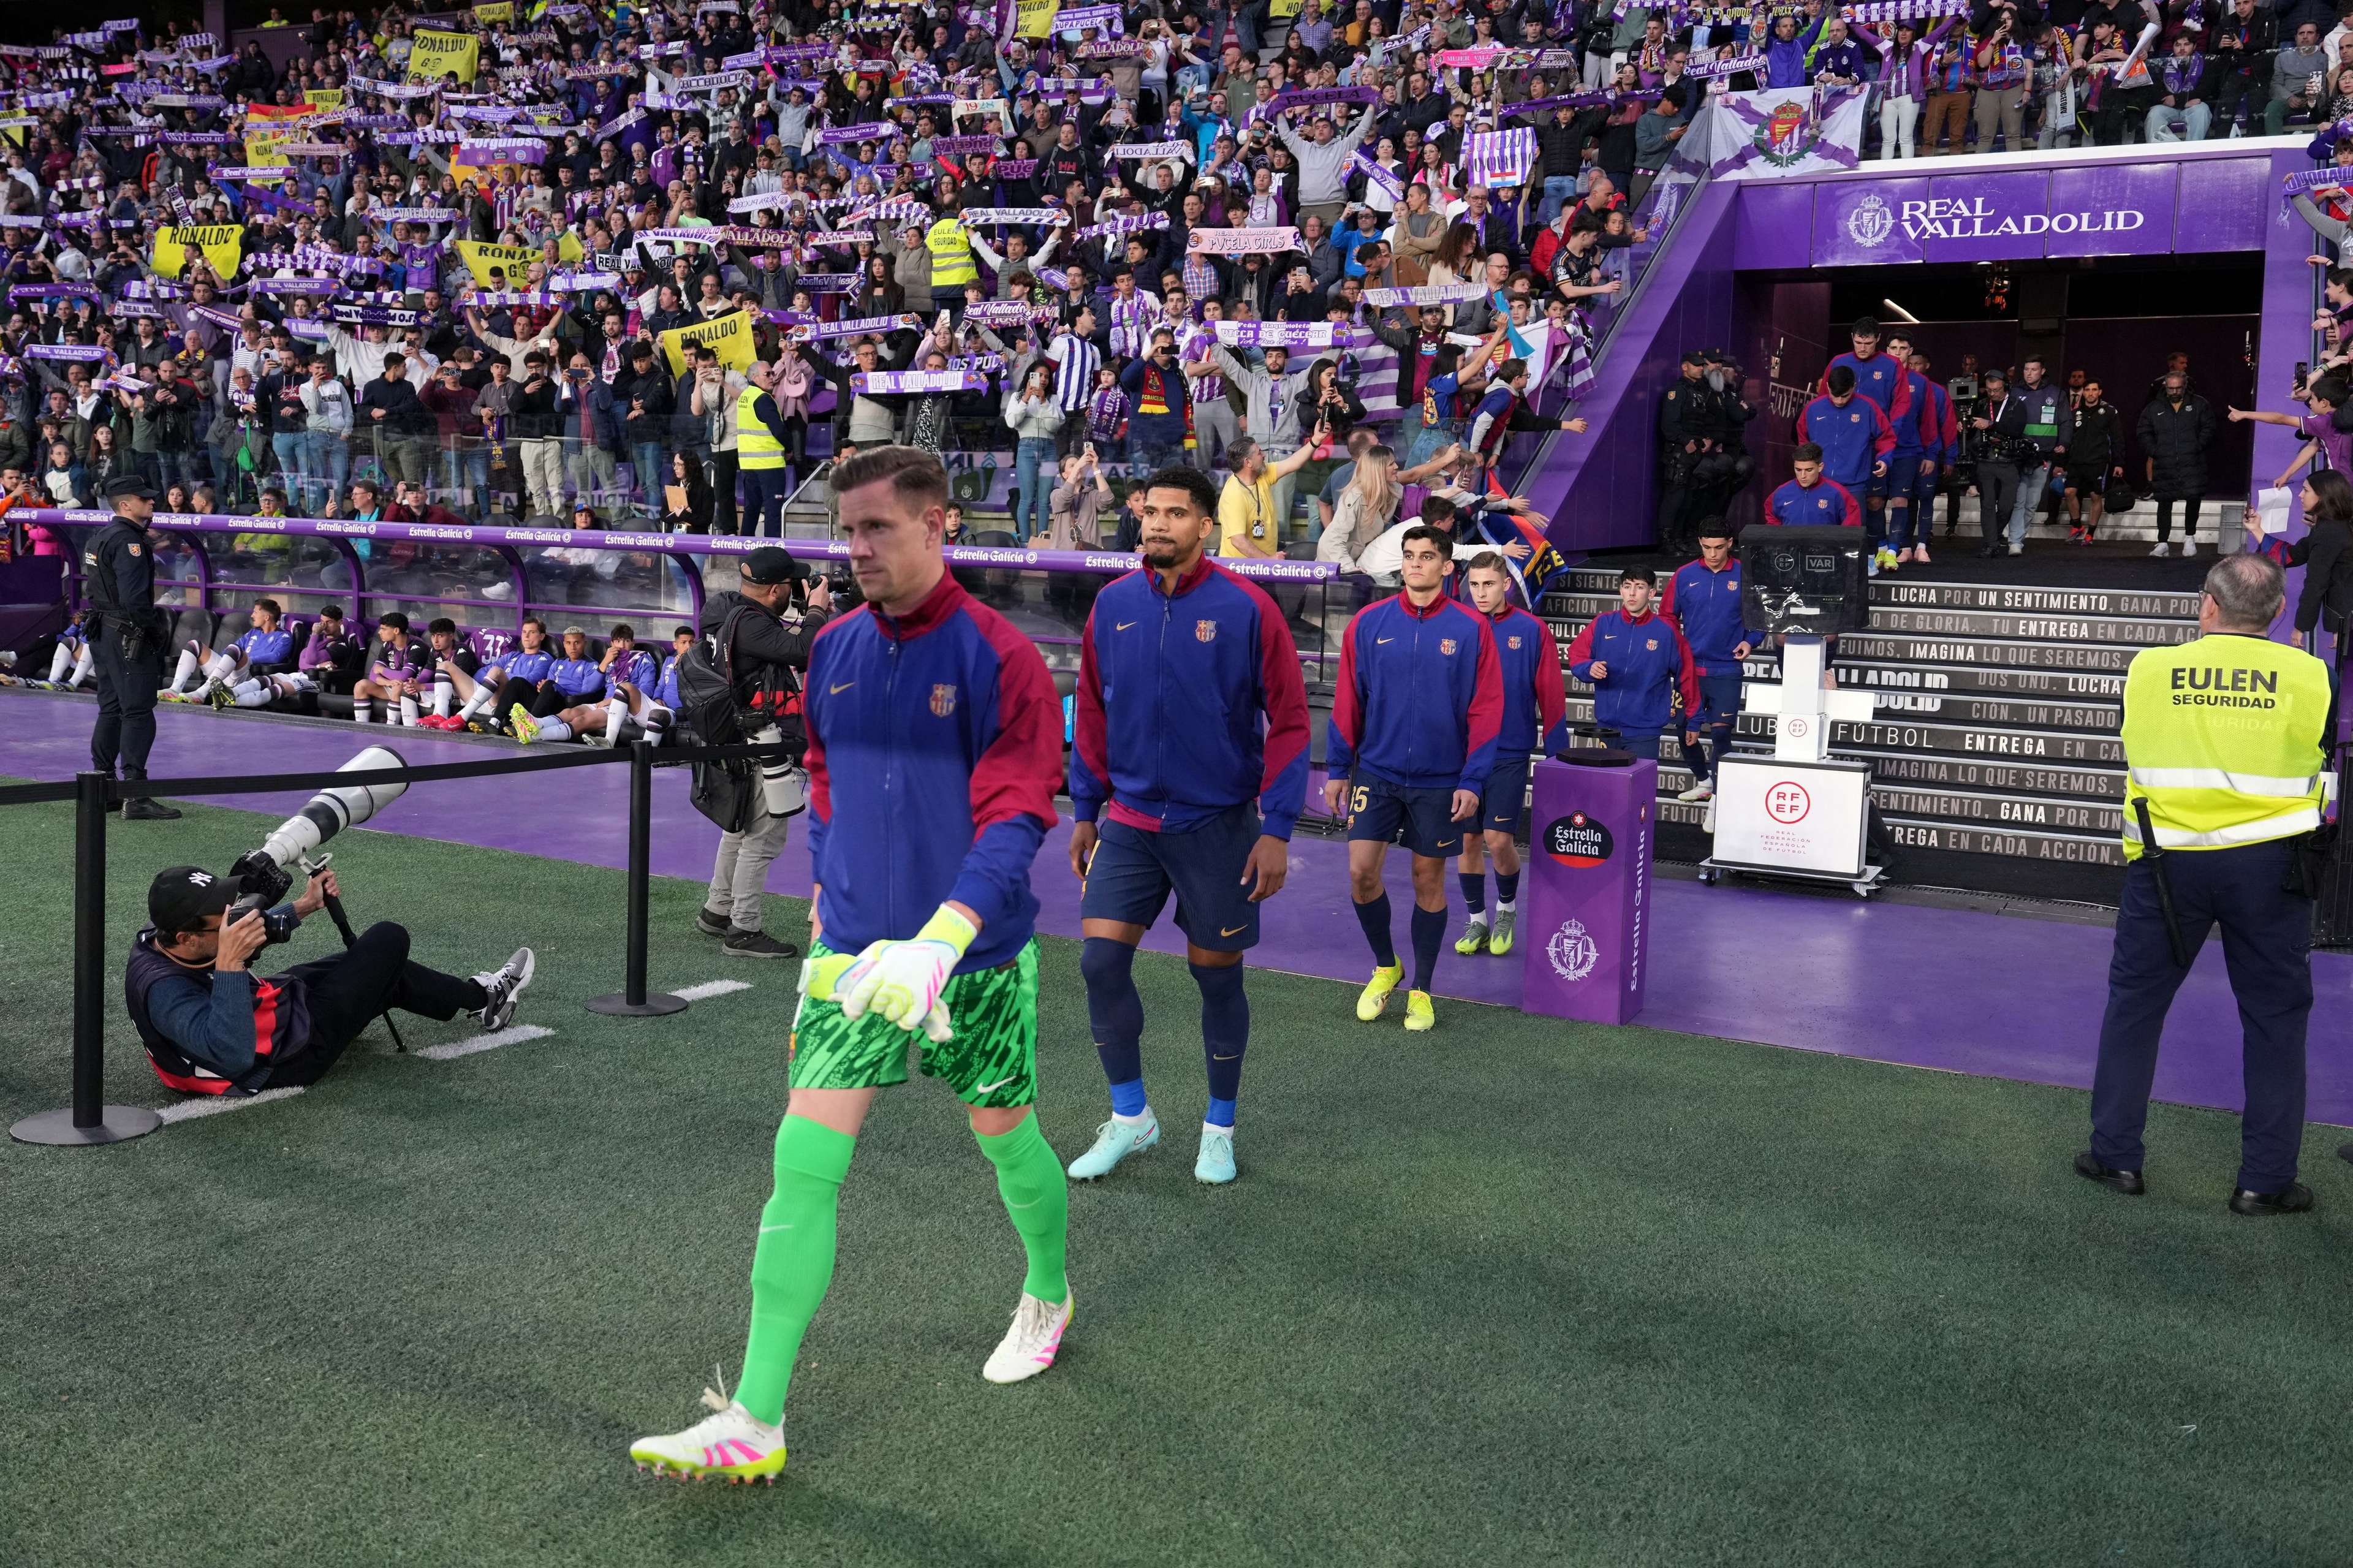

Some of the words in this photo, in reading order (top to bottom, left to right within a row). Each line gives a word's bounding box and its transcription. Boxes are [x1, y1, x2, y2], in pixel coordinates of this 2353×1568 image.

[1055, 20, 1075, 30] AUPA
[1075, 18, 1102, 28] PUCELA
[1683, 64, 1708, 76] Real
[313, 93, 339, 102] RONALDO
[1286, 90, 1361, 105] PUCELA
[223, 167, 244, 178] Real
[244, 167, 284, 178] Valladolid
[376, 208, 398, 219] REAL
[400, 208, 449, 219] VALLADOLID
[968, 208, 991, 219] REAL
[995, 208, 1055, 218] VALLADOLID
[1901, 197, 1995, 222] REAL
[1901, 210, 2144, 240] VALLADOLID
[169, 227, 234, 246] RONALDO
[819, 232, 847, 243] REAL
[1254, 235, 1286, 250] GIRLS
[598, 256, 621, 268] REAL
[1051, 275, 1067, 287] REAL
[1373, 290, 1406, 305] REAL
[1408, 284, 1482, 303] VALLADOLID
[333, 307, 352, 318] Real
[964, 306, 982, 316] Real
[820, 321, 840, 333] REAL
[841, 316, 889, 331] VALLADOLID
[1259, 329, 1279, 339] DE
[53, 349, 101, 357] VALLADOLID
[872, 375, 898, 389] REAL
[899, 373, 958, 389] VALLADOLID
[64, 512, 87, 521] Estrella
[87, 513, 109, 522] Galicia
[169, 516, 192, 525] Galicia
[228, 518, 252, 528] Estrella
[253, 520, 276, 529] Galicia
[316, 521, 342, 532] Estrella
[343, 523, 367, 534] Galicia
[409, 527, 436, 537] Estrella
[437, 528, 463, 539] Galicia
[505, 530, 534, 540] Estrella
[534, 531, 561, 542] Galicia
[605, 534, 635, 545] Estrella
[635, 536, 664, 547] Galicia
[710, 539, 743, 550] Estrella
[952, 549, 989, 561] Estrella
[990, 550, 1024, 562] Galicia
[1085, 556, 1124, 568] Estrella
[1229, 562, 1267, 575] Estrella
[1272, 564, 1311, 577] Galicia
[1809, 559, 1832, 568] VAR
[1559, 574, 1569, 587] SI
[1575, 575, 1620, 589] SIENTE
[1890, 587, 1937, 604] LUCHA
[1944, 589, 1971, 605] POR
[1979, 591, 1998, 606] UN
[2004, 591, 2114, 613] SENTIMIENTO,
[2120, 596, 2162, 614] GANA
[1890, 613, 1908, 629] DE
[1916, 615, 1977, 632] GLORIA.
[1992, 618, 2010, 634] TU
[2018, 619, 2090, 638] ENTREGA
[2097, 623, 2116, 640] EN
[2124, 624, 2167, 642] CADA
[1838, 639, 1901, 659] FUIMOS,
[1983, 646, 2001, 662] LO
[2009, 647, 2037, 665] QUE
[2045, 649, 2128, 668] SEREMOS.
[2068, 677, 2121, 694] LUCHA
[2171, 667, 2278, 694] EULEN
[2172, 694, 2276, 709] SEGURIDAD
[2028, 706, 2047, 723] UN
[2054, 710, 2116, 728] PASADO
[1838, 722, 1933, 748] FÚTBOL
[1965, 733, 2046, 756] ENTREGA
[2063, 740, 2085, 757] EN
[1877, 759, 1949, 781] IMAGINA
[1958, 765, 1976, 782] LO
[1985, 768, 2018, 786] QUE
[2025, 770, 2114, 795] SEREMOS.
[1871, 791, 1990, 819] SENTIMIENTO,
[1999, 801, 2045, 824] GANA
[2055, 807, 2088, 827] POR
[2098, 811, 2121, 829] UN
[1554, 825, 1602, 843] Estrella
[1555, 838, 1599, 856] Galicia
[1948, 831, 1970, 850] EN
[1981, 834, 2027, 855] CADA
[2039, 838, 2118, 866] ACCIÓN,
[1635, 828, 1645, 907] Galicia
[1631, 909, 1641, 992] Estrella
